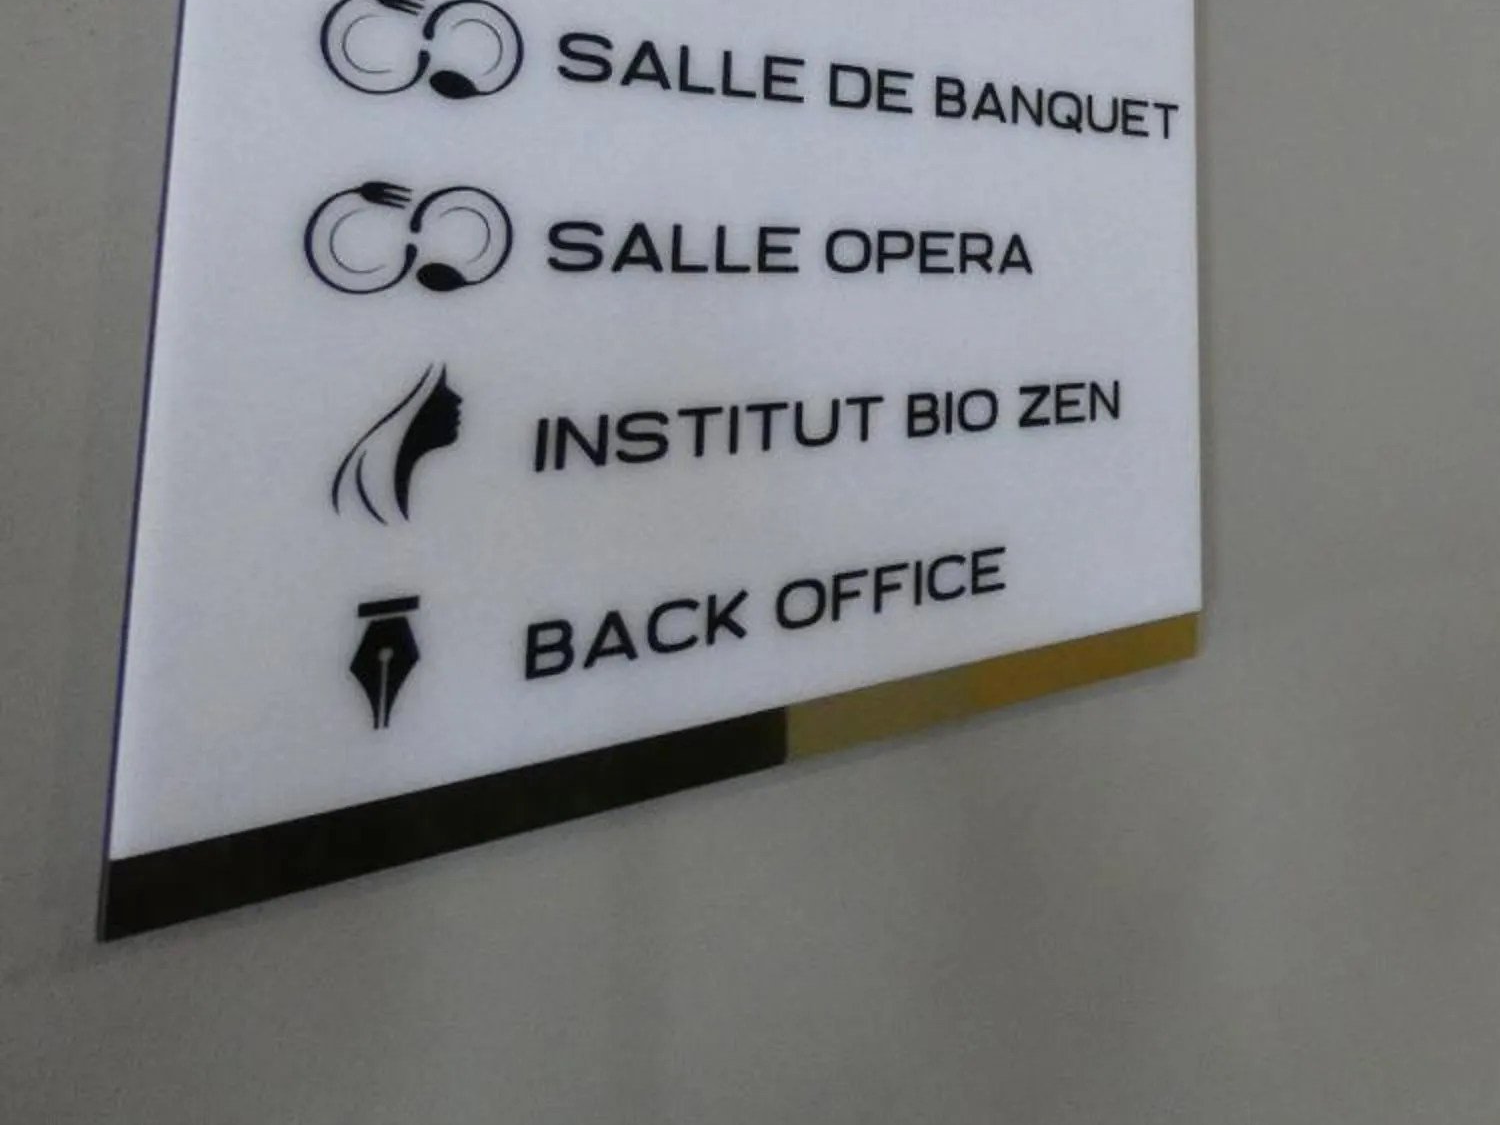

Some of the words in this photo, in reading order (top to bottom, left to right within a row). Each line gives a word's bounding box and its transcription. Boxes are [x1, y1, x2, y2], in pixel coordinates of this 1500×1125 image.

[556, 31, 806, 104] SALLE
[828, 62, 915, 115] DE
[934, 75, 1180, 140] BANQUET
[546, 219, 801, 275] SALLE
[824, 227, 1034, 276] OPERA
[531, 394, 885, 475] INSTITUT
[905, 387, 1000, 440] BIO
[1017, 379, 1121, 430] ZEN
[522, 587, 750, 682] BACK
[773, 545, 1007, 632] OFFICE
